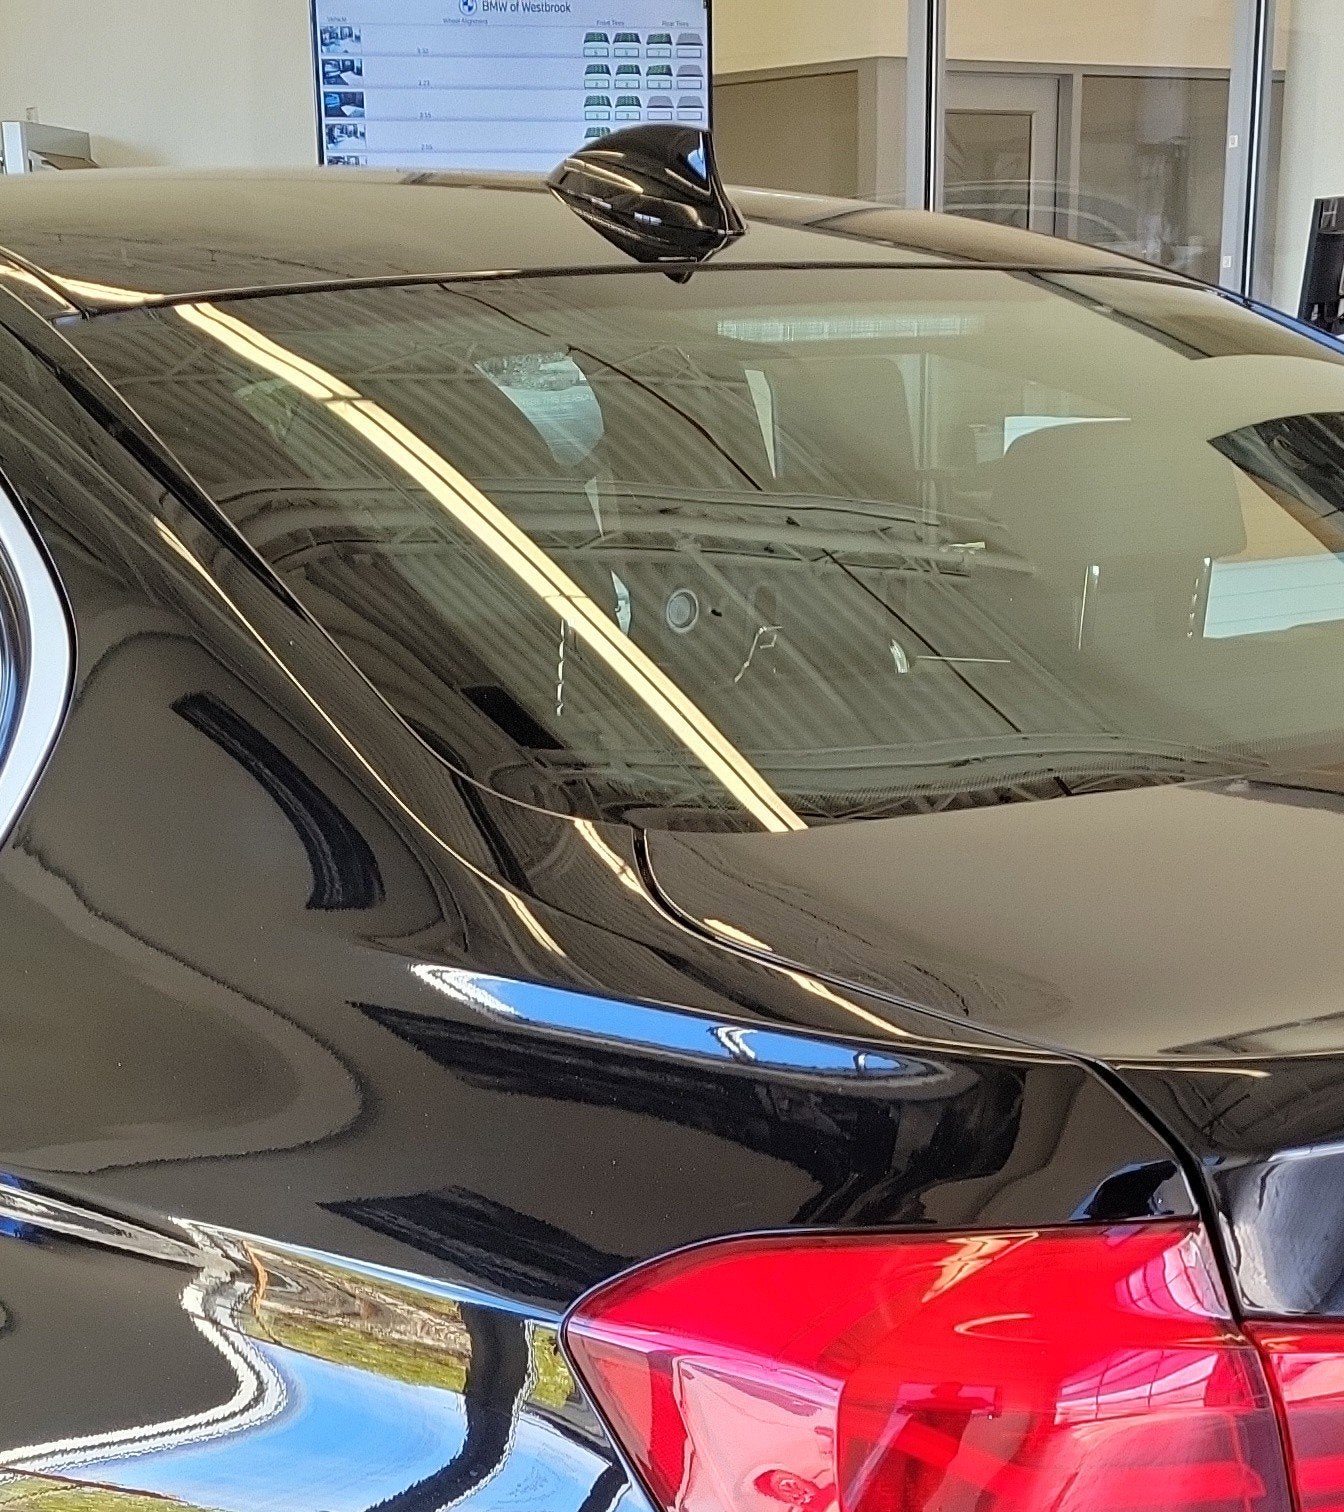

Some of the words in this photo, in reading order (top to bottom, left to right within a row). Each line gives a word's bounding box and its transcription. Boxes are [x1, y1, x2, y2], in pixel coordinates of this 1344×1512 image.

[482, 1, 506, 13] BMW
[509, 1, 520, 13] of
[523, 1, 571, 14] Westbrook
